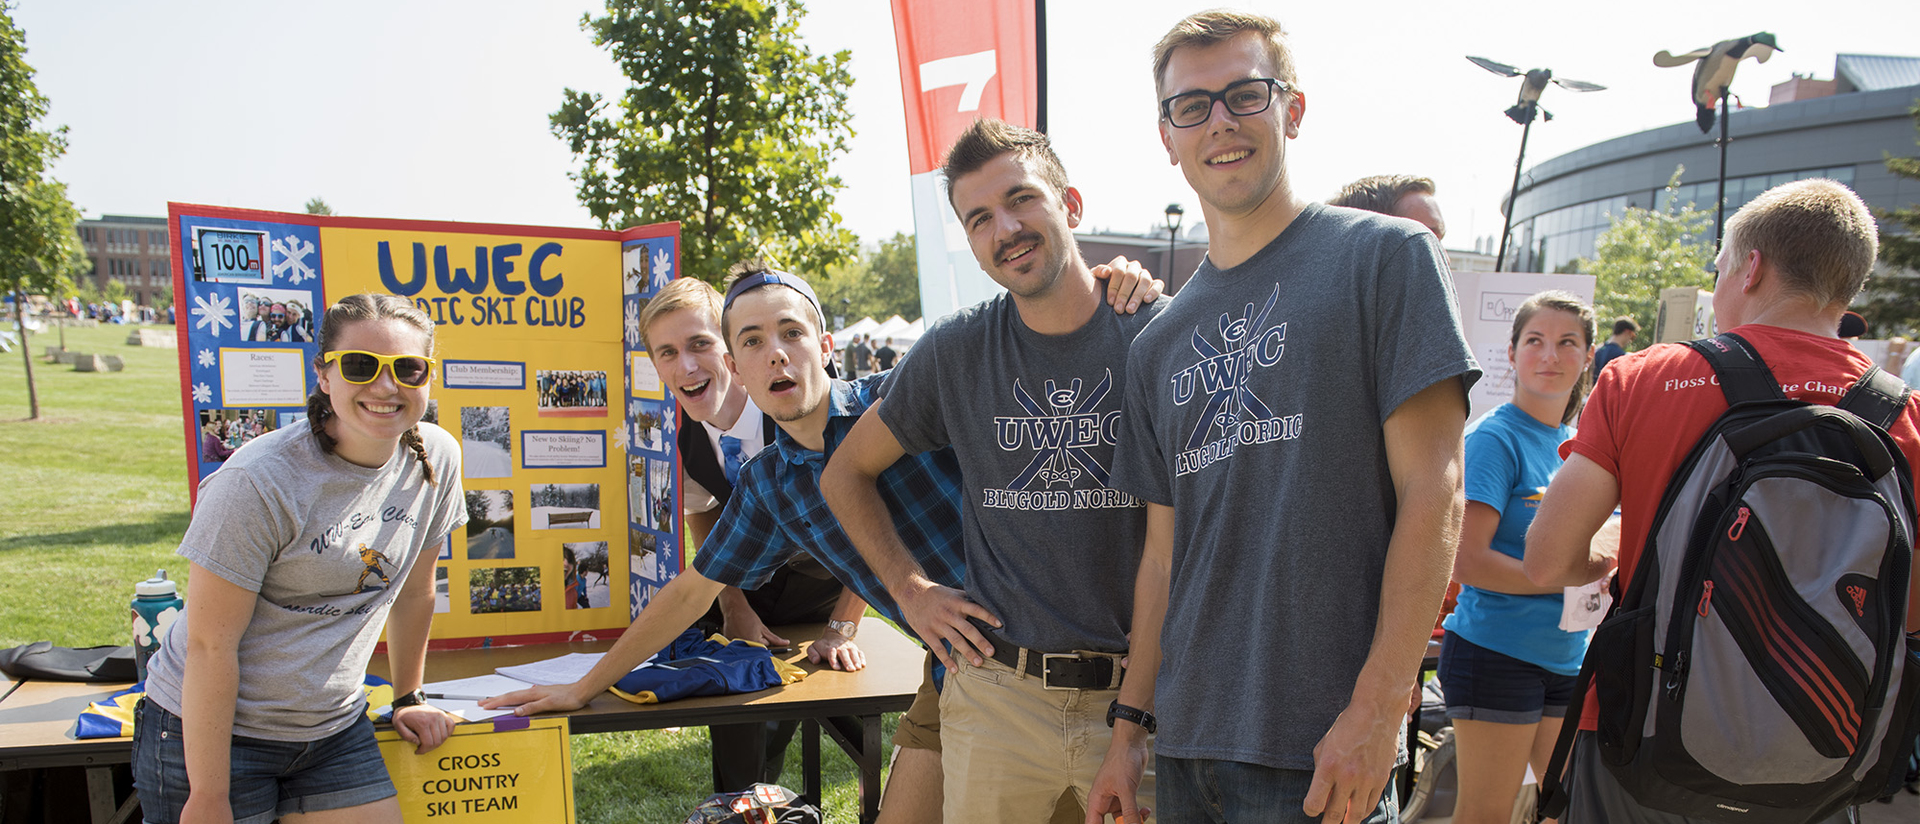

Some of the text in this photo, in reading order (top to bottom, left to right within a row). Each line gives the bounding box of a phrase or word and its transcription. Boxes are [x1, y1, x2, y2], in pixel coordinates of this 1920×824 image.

[210, 244, 250, 271] 100
[377, 241, 564, 297] UWEC
[415, 296, 586, 329] DIC SKI CLUB
[250, 353, 274, 362] Races:
[450, 365, 519, 376] Club Membership:
[1664, 375, 1706, 392] Floss
[1804, 380, 1849, 398] Chan
[532, 435, 548, 443] New
[549, 435, 558, 443] to
[558, 436, 585, 445] Skiing?
[1236, 413, 1303, 446] ORDIC
[983, 488, 1070, 510] BLUGOLD
[437, 753, 501, 772] CROSS
[422, 773, 520, 795] COUNTRY
[426, 795, 519, 818] SKI TEAM
